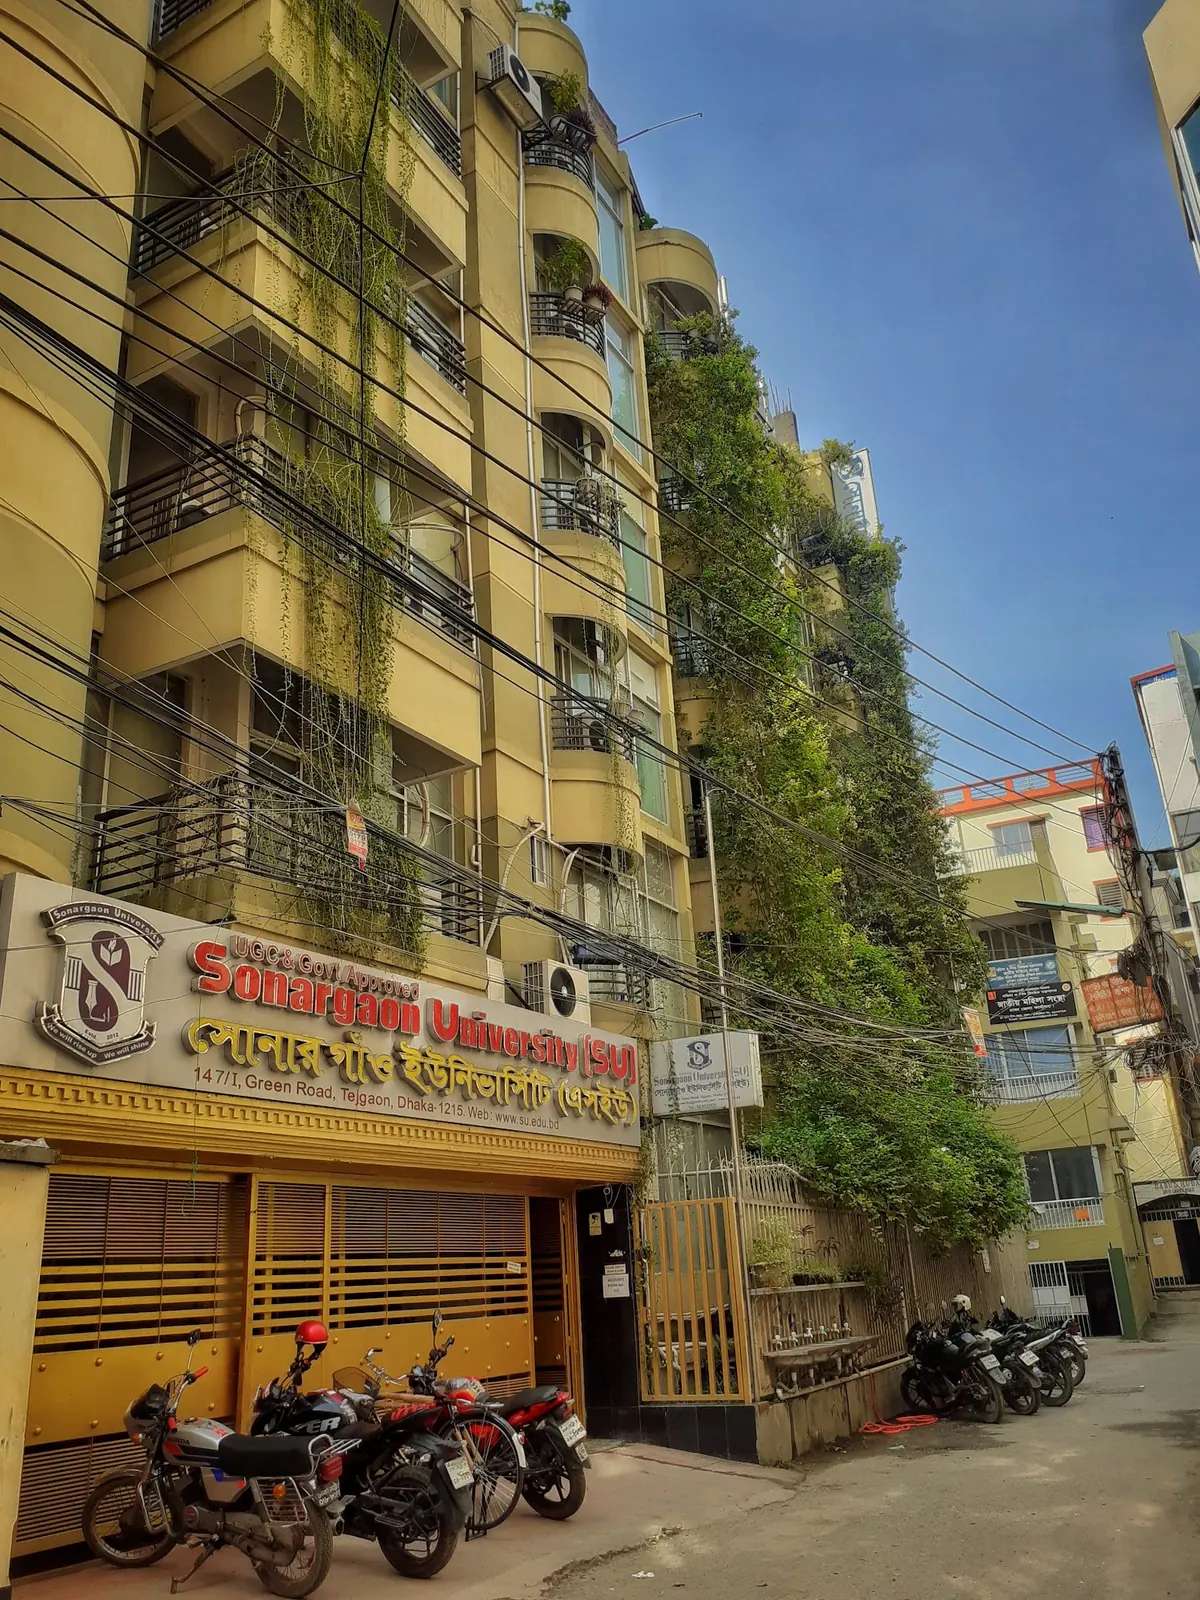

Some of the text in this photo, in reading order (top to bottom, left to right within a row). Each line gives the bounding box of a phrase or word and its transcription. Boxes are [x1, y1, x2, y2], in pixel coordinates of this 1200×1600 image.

[53, 905, 163, 945] Sonargaon University
[300, 953, 342, 981] Govt
[346, 965, 420, 1000] Approved
[193, 940, 421, 1036] Sonargaon
[432, 999, 579, 1072] University
[47, 1022, 98, 1060] We will rise up
[103, 1040, 150, 1060] We will shine
[106, 1031, 119, 1040] 2012
[188, 1016, 637, 1127] সোনারগাঁও ইউনিভার্সিটি (এসইউ)
[245, 1074, 292, 1094] Green
[296, 1081, 335, 1101] Road,
[340, 1087, 394, 1110] Tejgaon,
[495, 1113, 559, 1130] www.su.edu.bd
